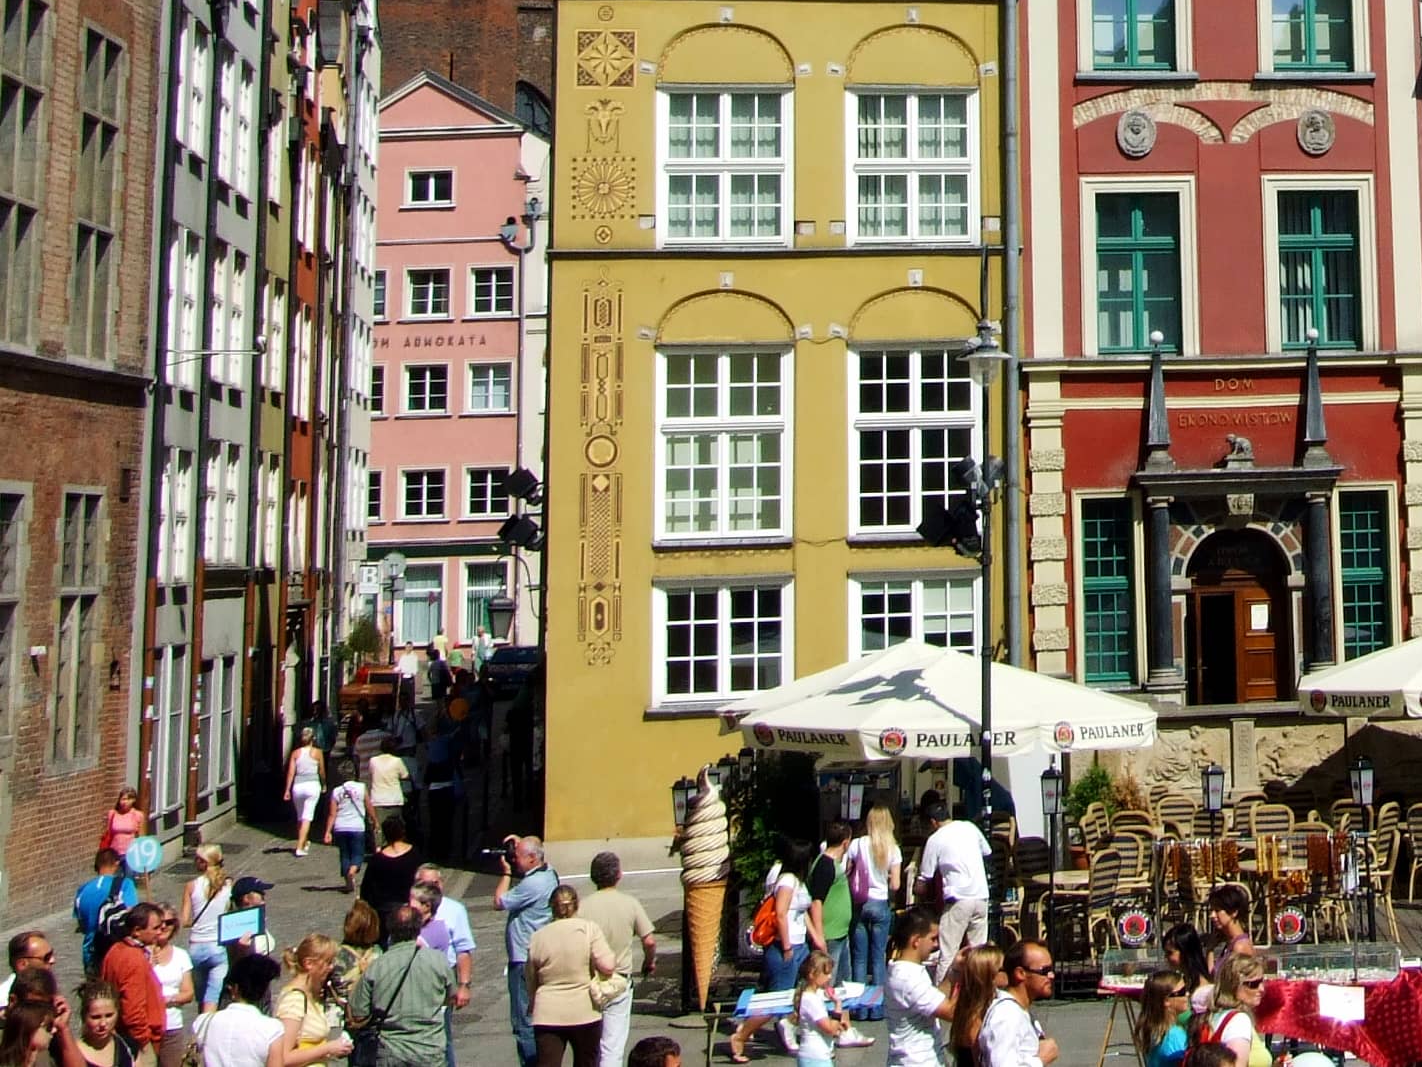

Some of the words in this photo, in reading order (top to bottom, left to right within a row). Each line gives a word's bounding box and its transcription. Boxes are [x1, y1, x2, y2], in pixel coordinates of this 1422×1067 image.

[1215, 378, 1254, 391] DOM
[1331, 694, 1391, 708] PAULANER
[777, 729, 850, 746] PAULANER
[916, 731, 1017, 748] PAULAER
[1080, 722, 1145, 740] PAULANER
[129, 839, 157, 866] 19
